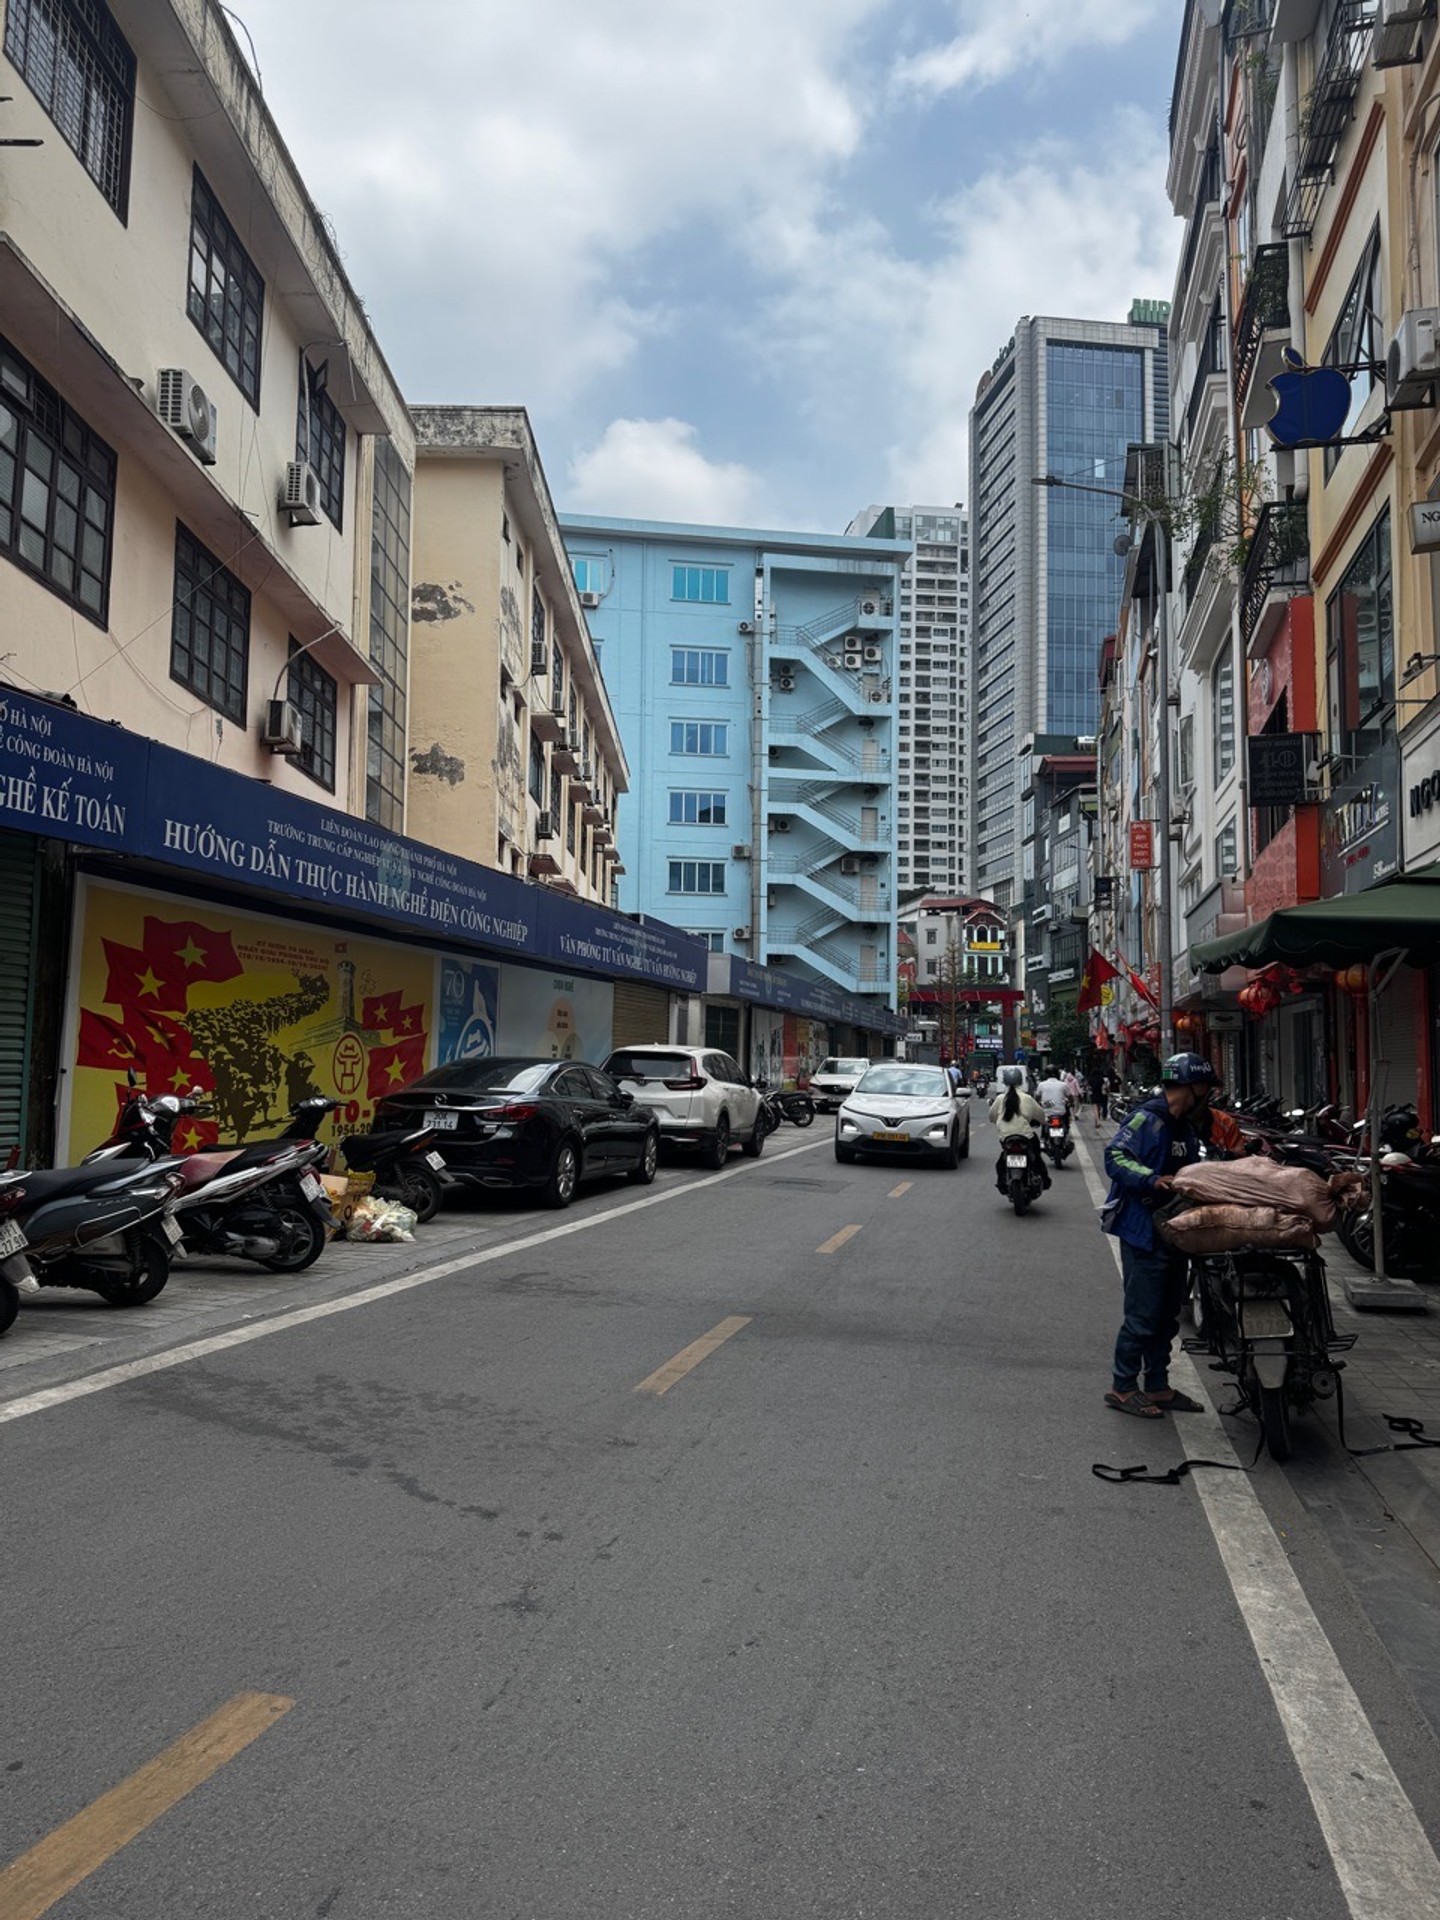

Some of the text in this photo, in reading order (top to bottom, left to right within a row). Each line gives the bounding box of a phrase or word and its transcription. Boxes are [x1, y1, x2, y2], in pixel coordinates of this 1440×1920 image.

[10, 707, 27, 729] HÀ
[30, 715, 52, 738] NỘI
[7, 734, 41, 760] CÔNG
[43, 747, 75, 771] ĐOÀN
[77, 754, 92, 775] HÀ
[95, 761, 114, 783] NỘI
[41, 776, 72, 822] KẾ
[75, 793, 127, 836] TOÁN
[267, 819, 306, 843] TRƯỜNG
[306, 833, 336, 853] TRUNG
[162, 818, 528, 946] HƯỚNG DẪN THỰC HÀNH NGHỀ ĐIỆN CÔNG NGHIỆP
